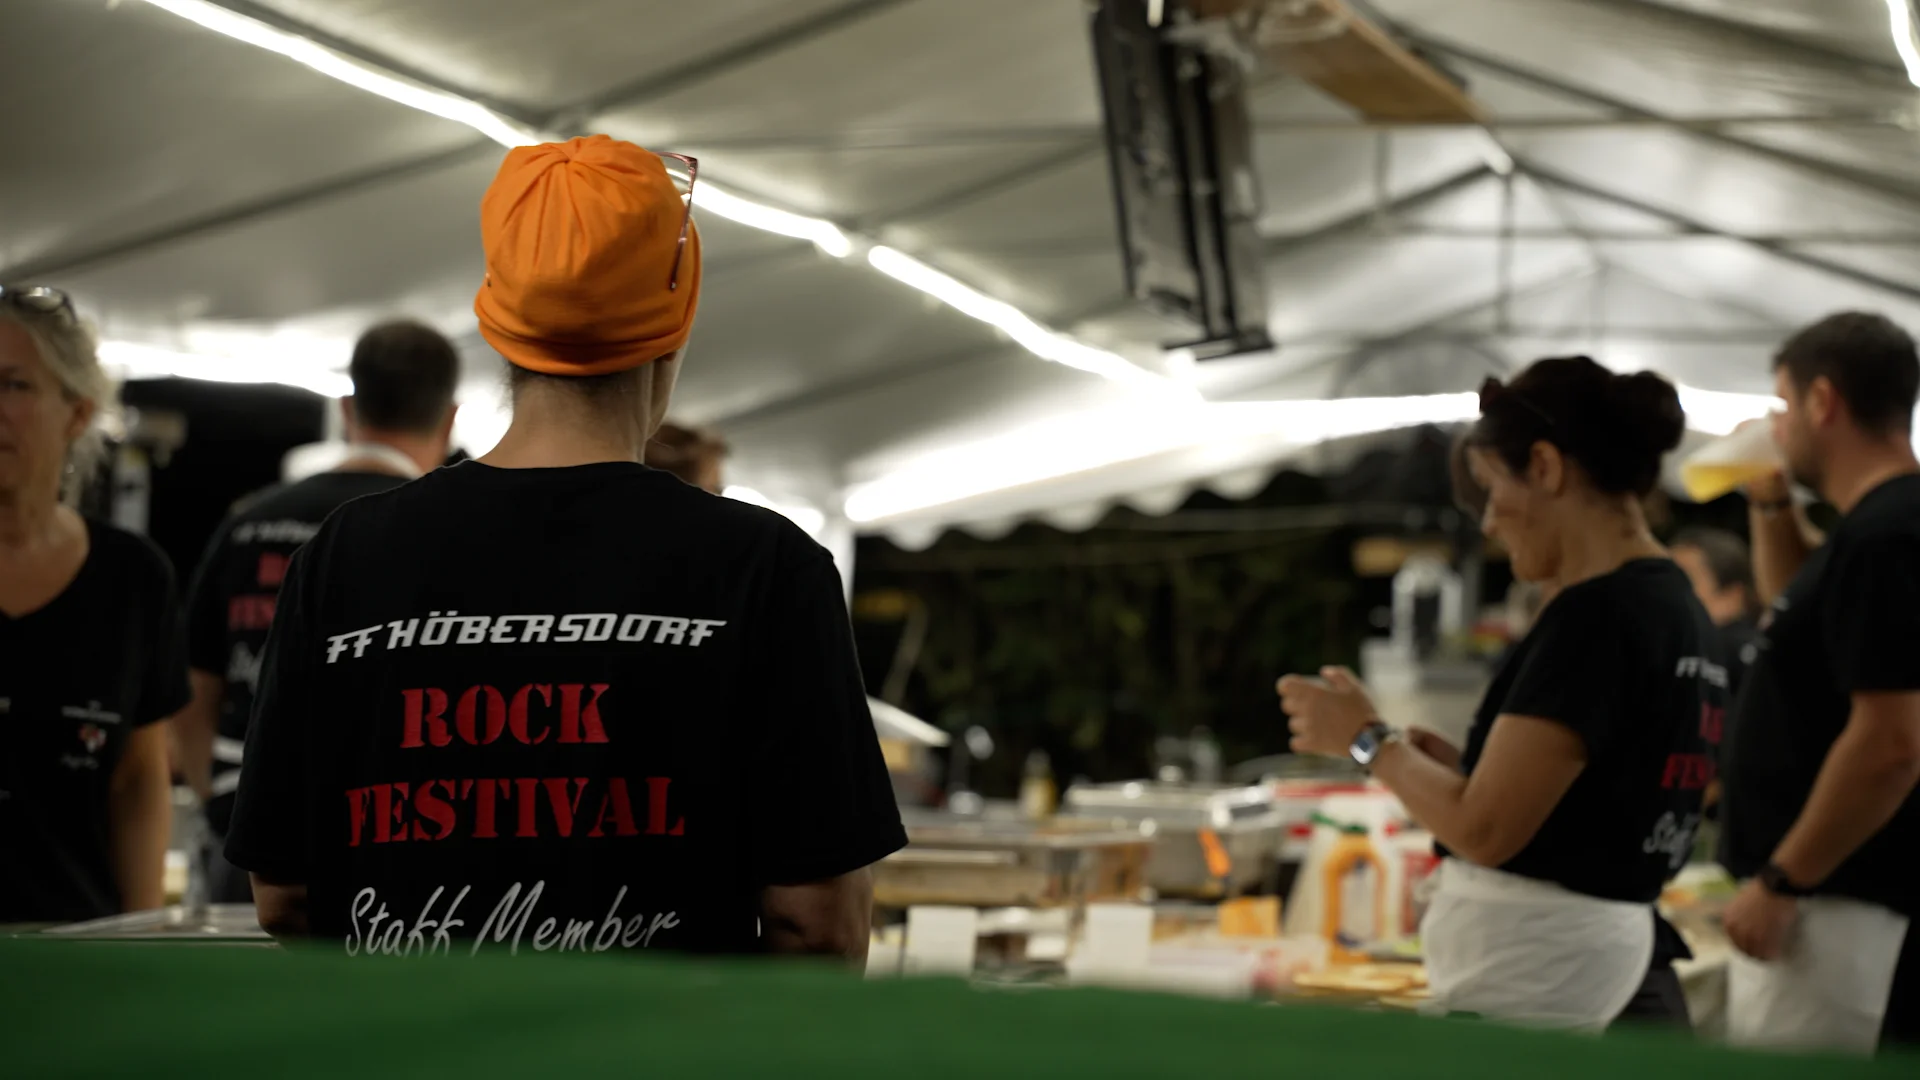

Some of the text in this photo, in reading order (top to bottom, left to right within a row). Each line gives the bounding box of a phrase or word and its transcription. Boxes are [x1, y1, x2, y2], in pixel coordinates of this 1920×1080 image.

[326, 610, 728, 664] FF HÖBERSDORF
[400, 683, 609, 749] ROCK
[345, 777, 686, 847] FESTIVAL
[344, 879, 682, 957] Staff Member
